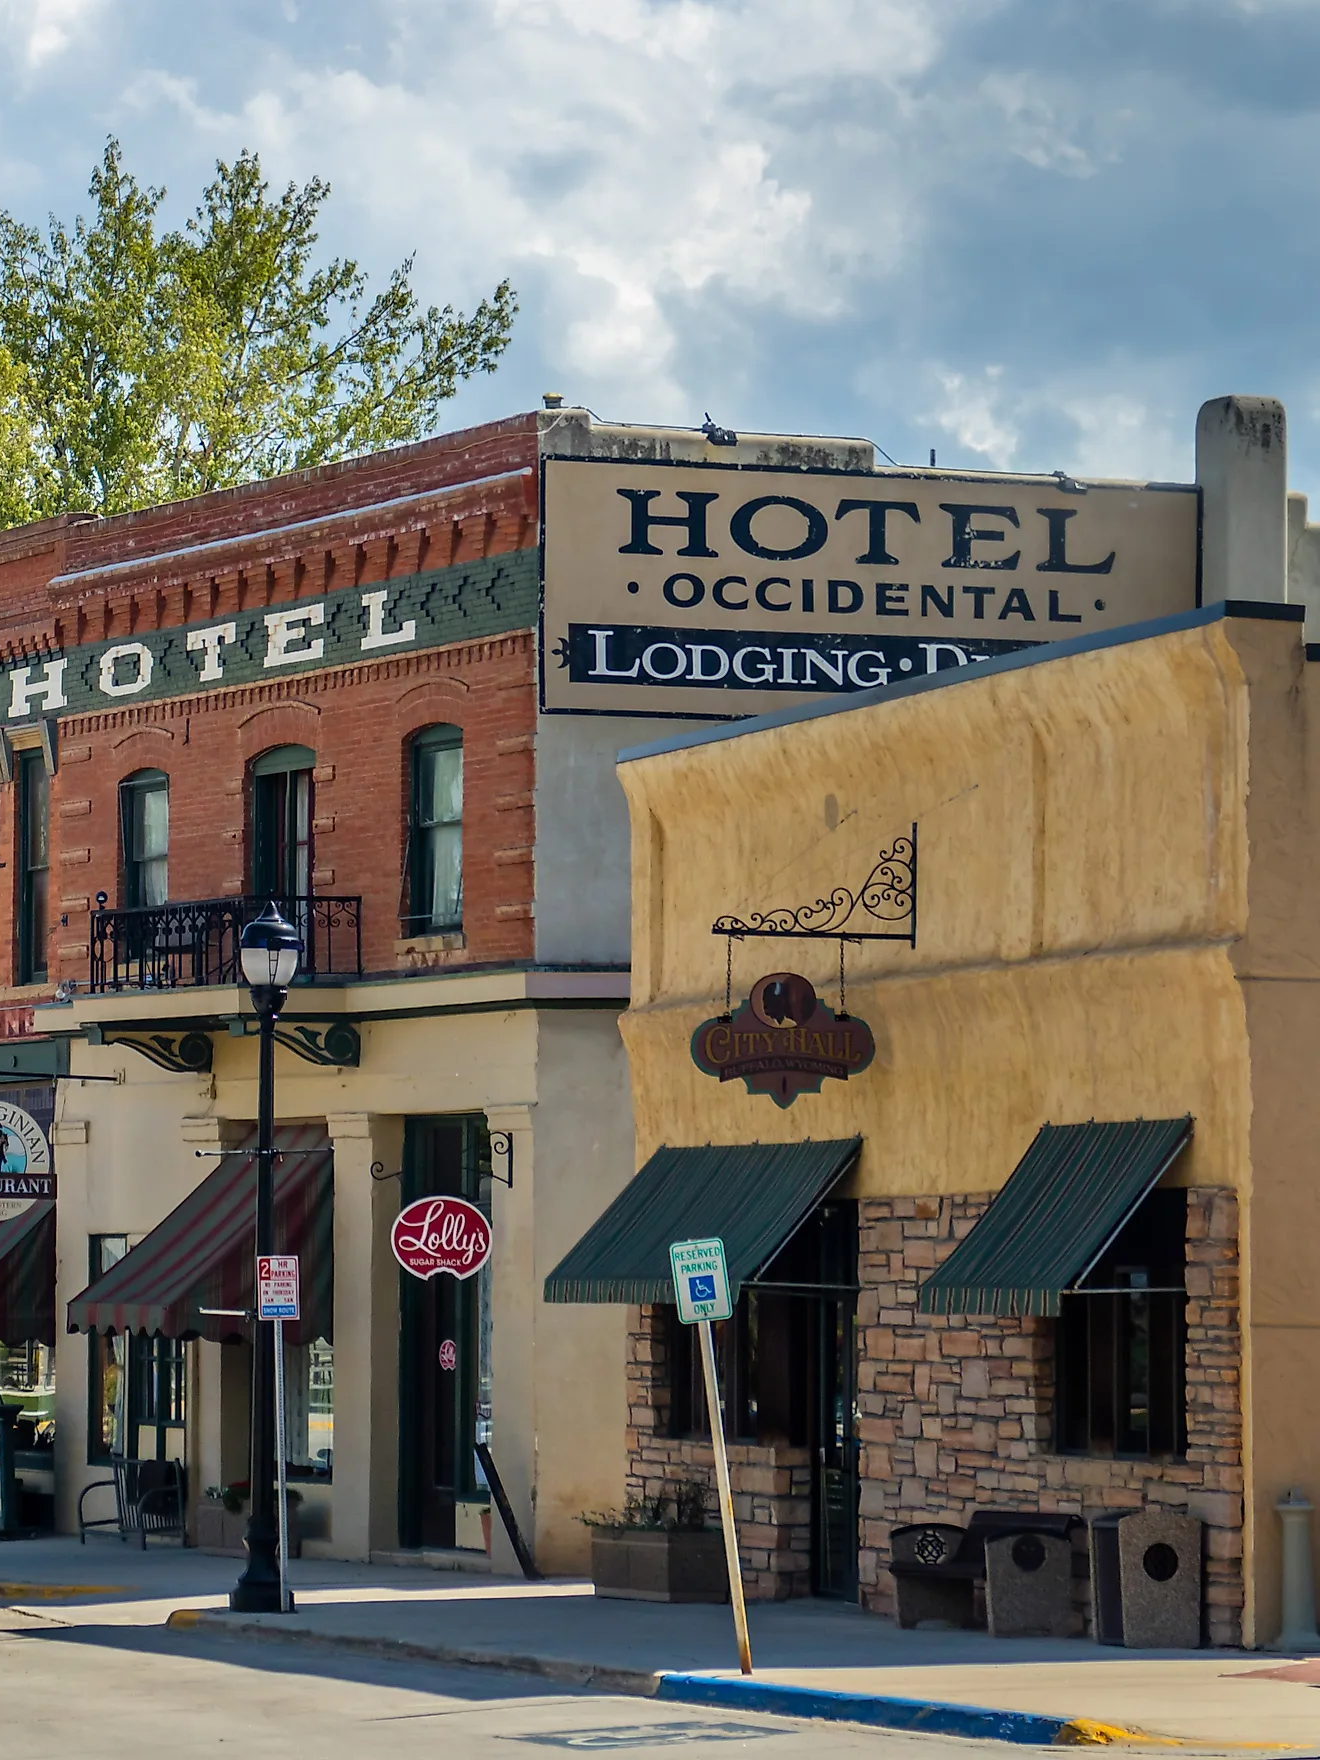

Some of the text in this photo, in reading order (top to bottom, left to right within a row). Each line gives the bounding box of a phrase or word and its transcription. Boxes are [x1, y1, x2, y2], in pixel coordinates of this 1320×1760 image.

[616, 488, 1116, 574] HOTEL
[662, 572, 1083, 622] OCCIDENTAL
[7, 589, 417, 719] HOTEL
[705, 1026, 862, 1064] CITY HALL
[398, 1200, 487, 1265] Lolly's
[675, 1247, 720, 1261] RESERVED
[261, 1261, 270, 1277] 2
[277, 1261, 288, 1269] HR
[409, 1258, 462, 1267] SUGAR SHACK
[681, 1261, 718, 1274] PARKING
[271, 1270, 295, 1279] PARKING
[694, 1303, 715, 1314] ONLY
